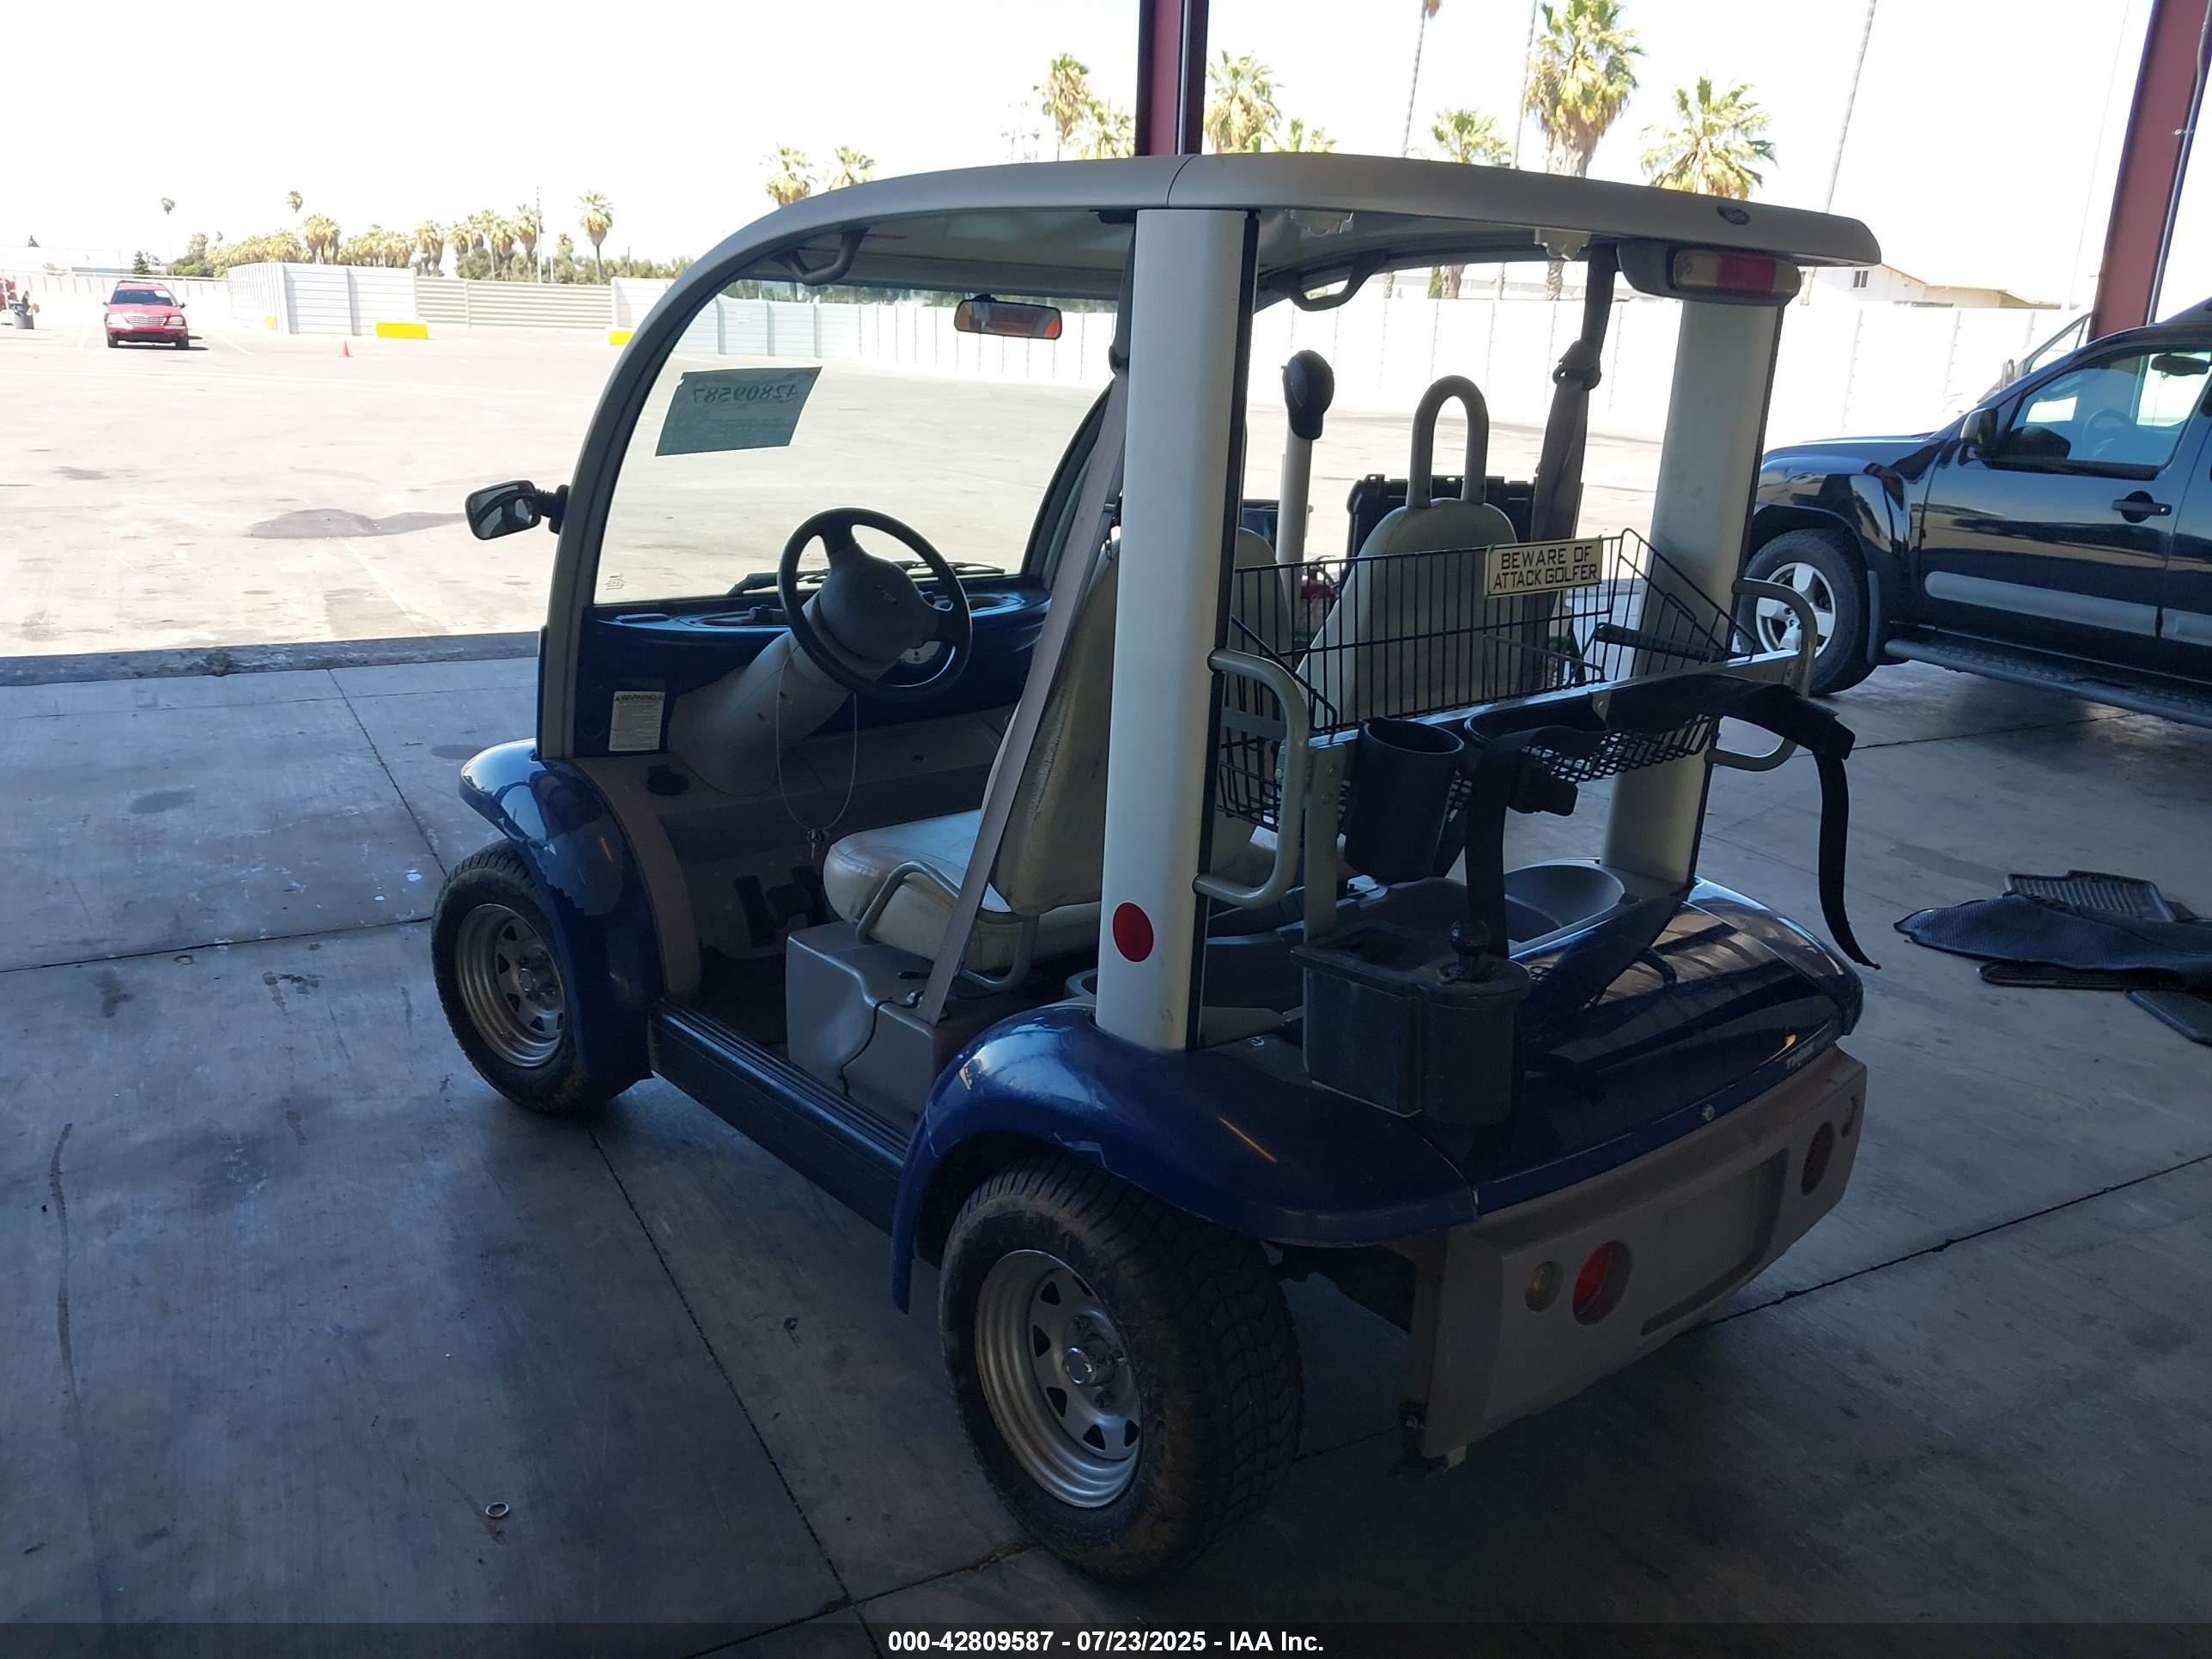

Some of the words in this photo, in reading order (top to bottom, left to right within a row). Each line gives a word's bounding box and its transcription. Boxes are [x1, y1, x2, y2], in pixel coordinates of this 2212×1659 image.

[1501, 548, 1566, 569] BEWARE
[1573, 545, 1593, 563] OF
[1492, 568, 1542, 590] ATTACK
[1545, 564, 1597, 584] GOLFER
